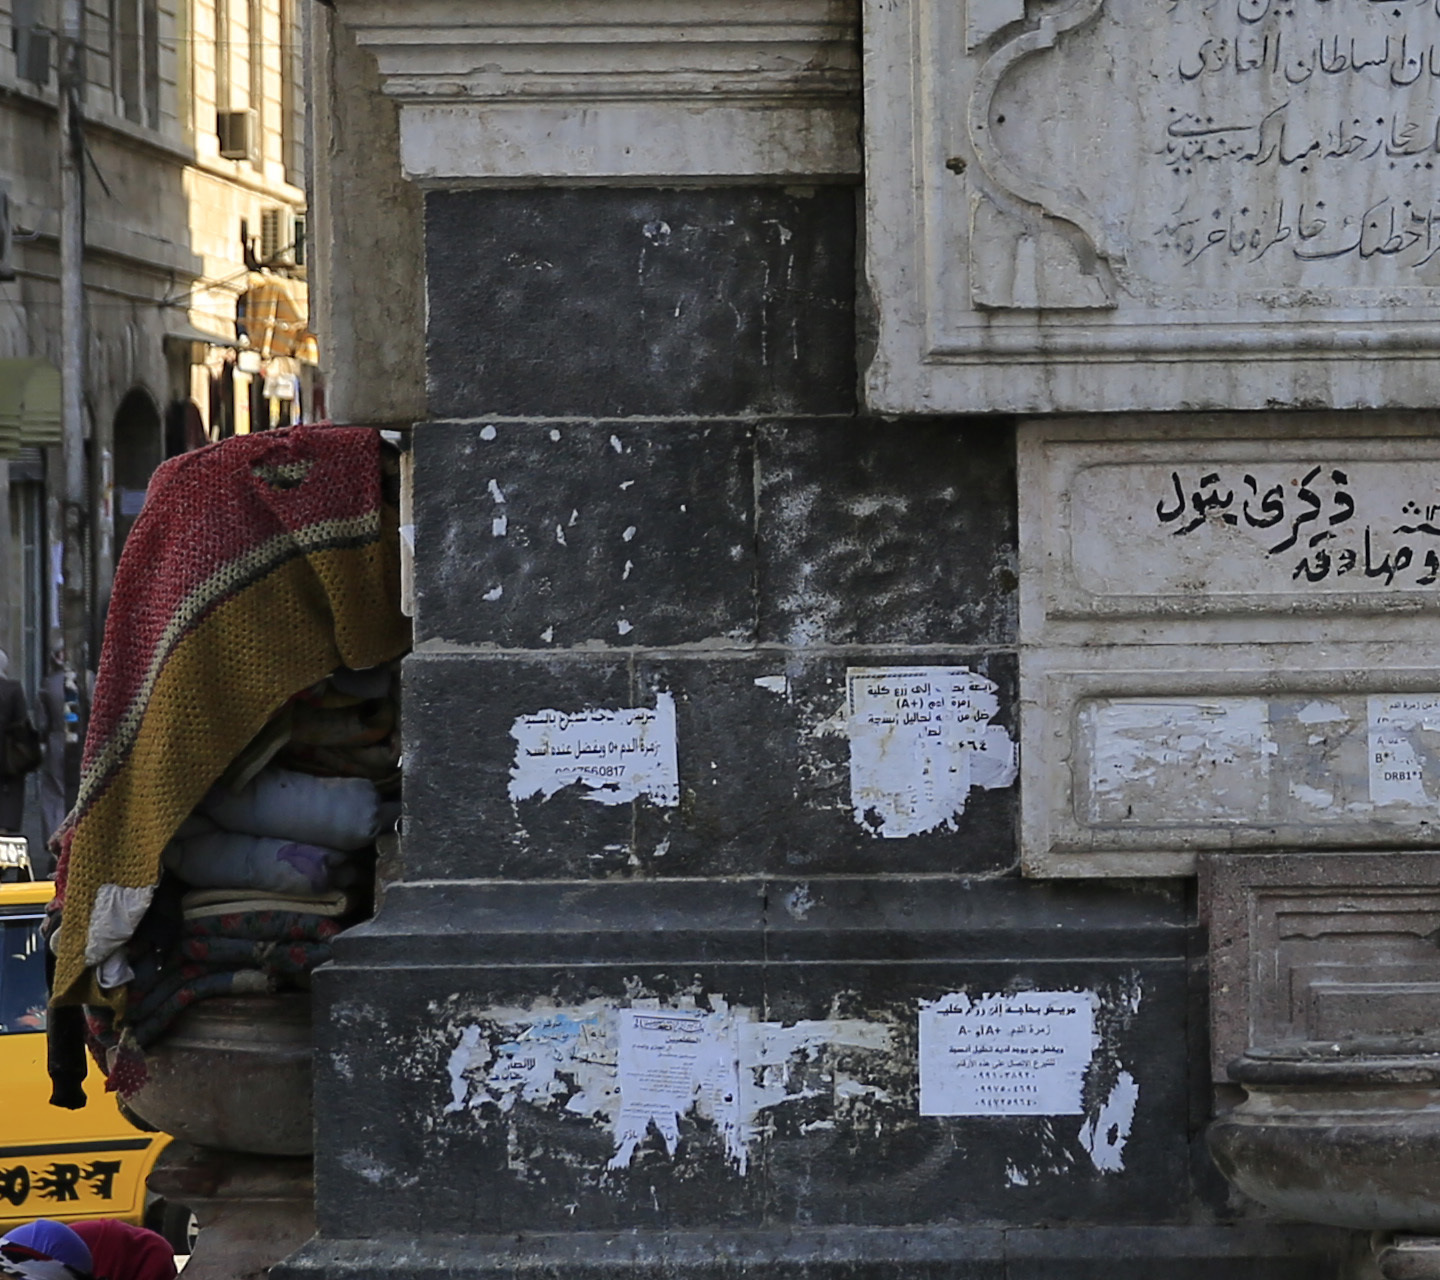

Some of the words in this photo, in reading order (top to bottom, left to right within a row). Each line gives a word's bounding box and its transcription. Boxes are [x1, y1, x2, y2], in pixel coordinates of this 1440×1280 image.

[1285, 34, 1405, 84] السلطان
[868, 685, 890, 697] كلية
[551, 742, 572, 755] عنده
[575, 740, 606, 759] ويفضل
[620, 738, 639, 760] الدم
[640, 739, 660, 757] زمرة
[1006, 1004, 1041, 1016] بحاجة
[1043, 1004, 1076, 1016] مريض
[1011, 1025, 1026, 1036] الدم
[1029, 1024, 1051, 1035] زمرة
[995, 1045, 1011, 1054] لديه
[1012, 1046, 1029, 1054] يوجد
[1040, 1045, 1064, 1054] ويفضل
